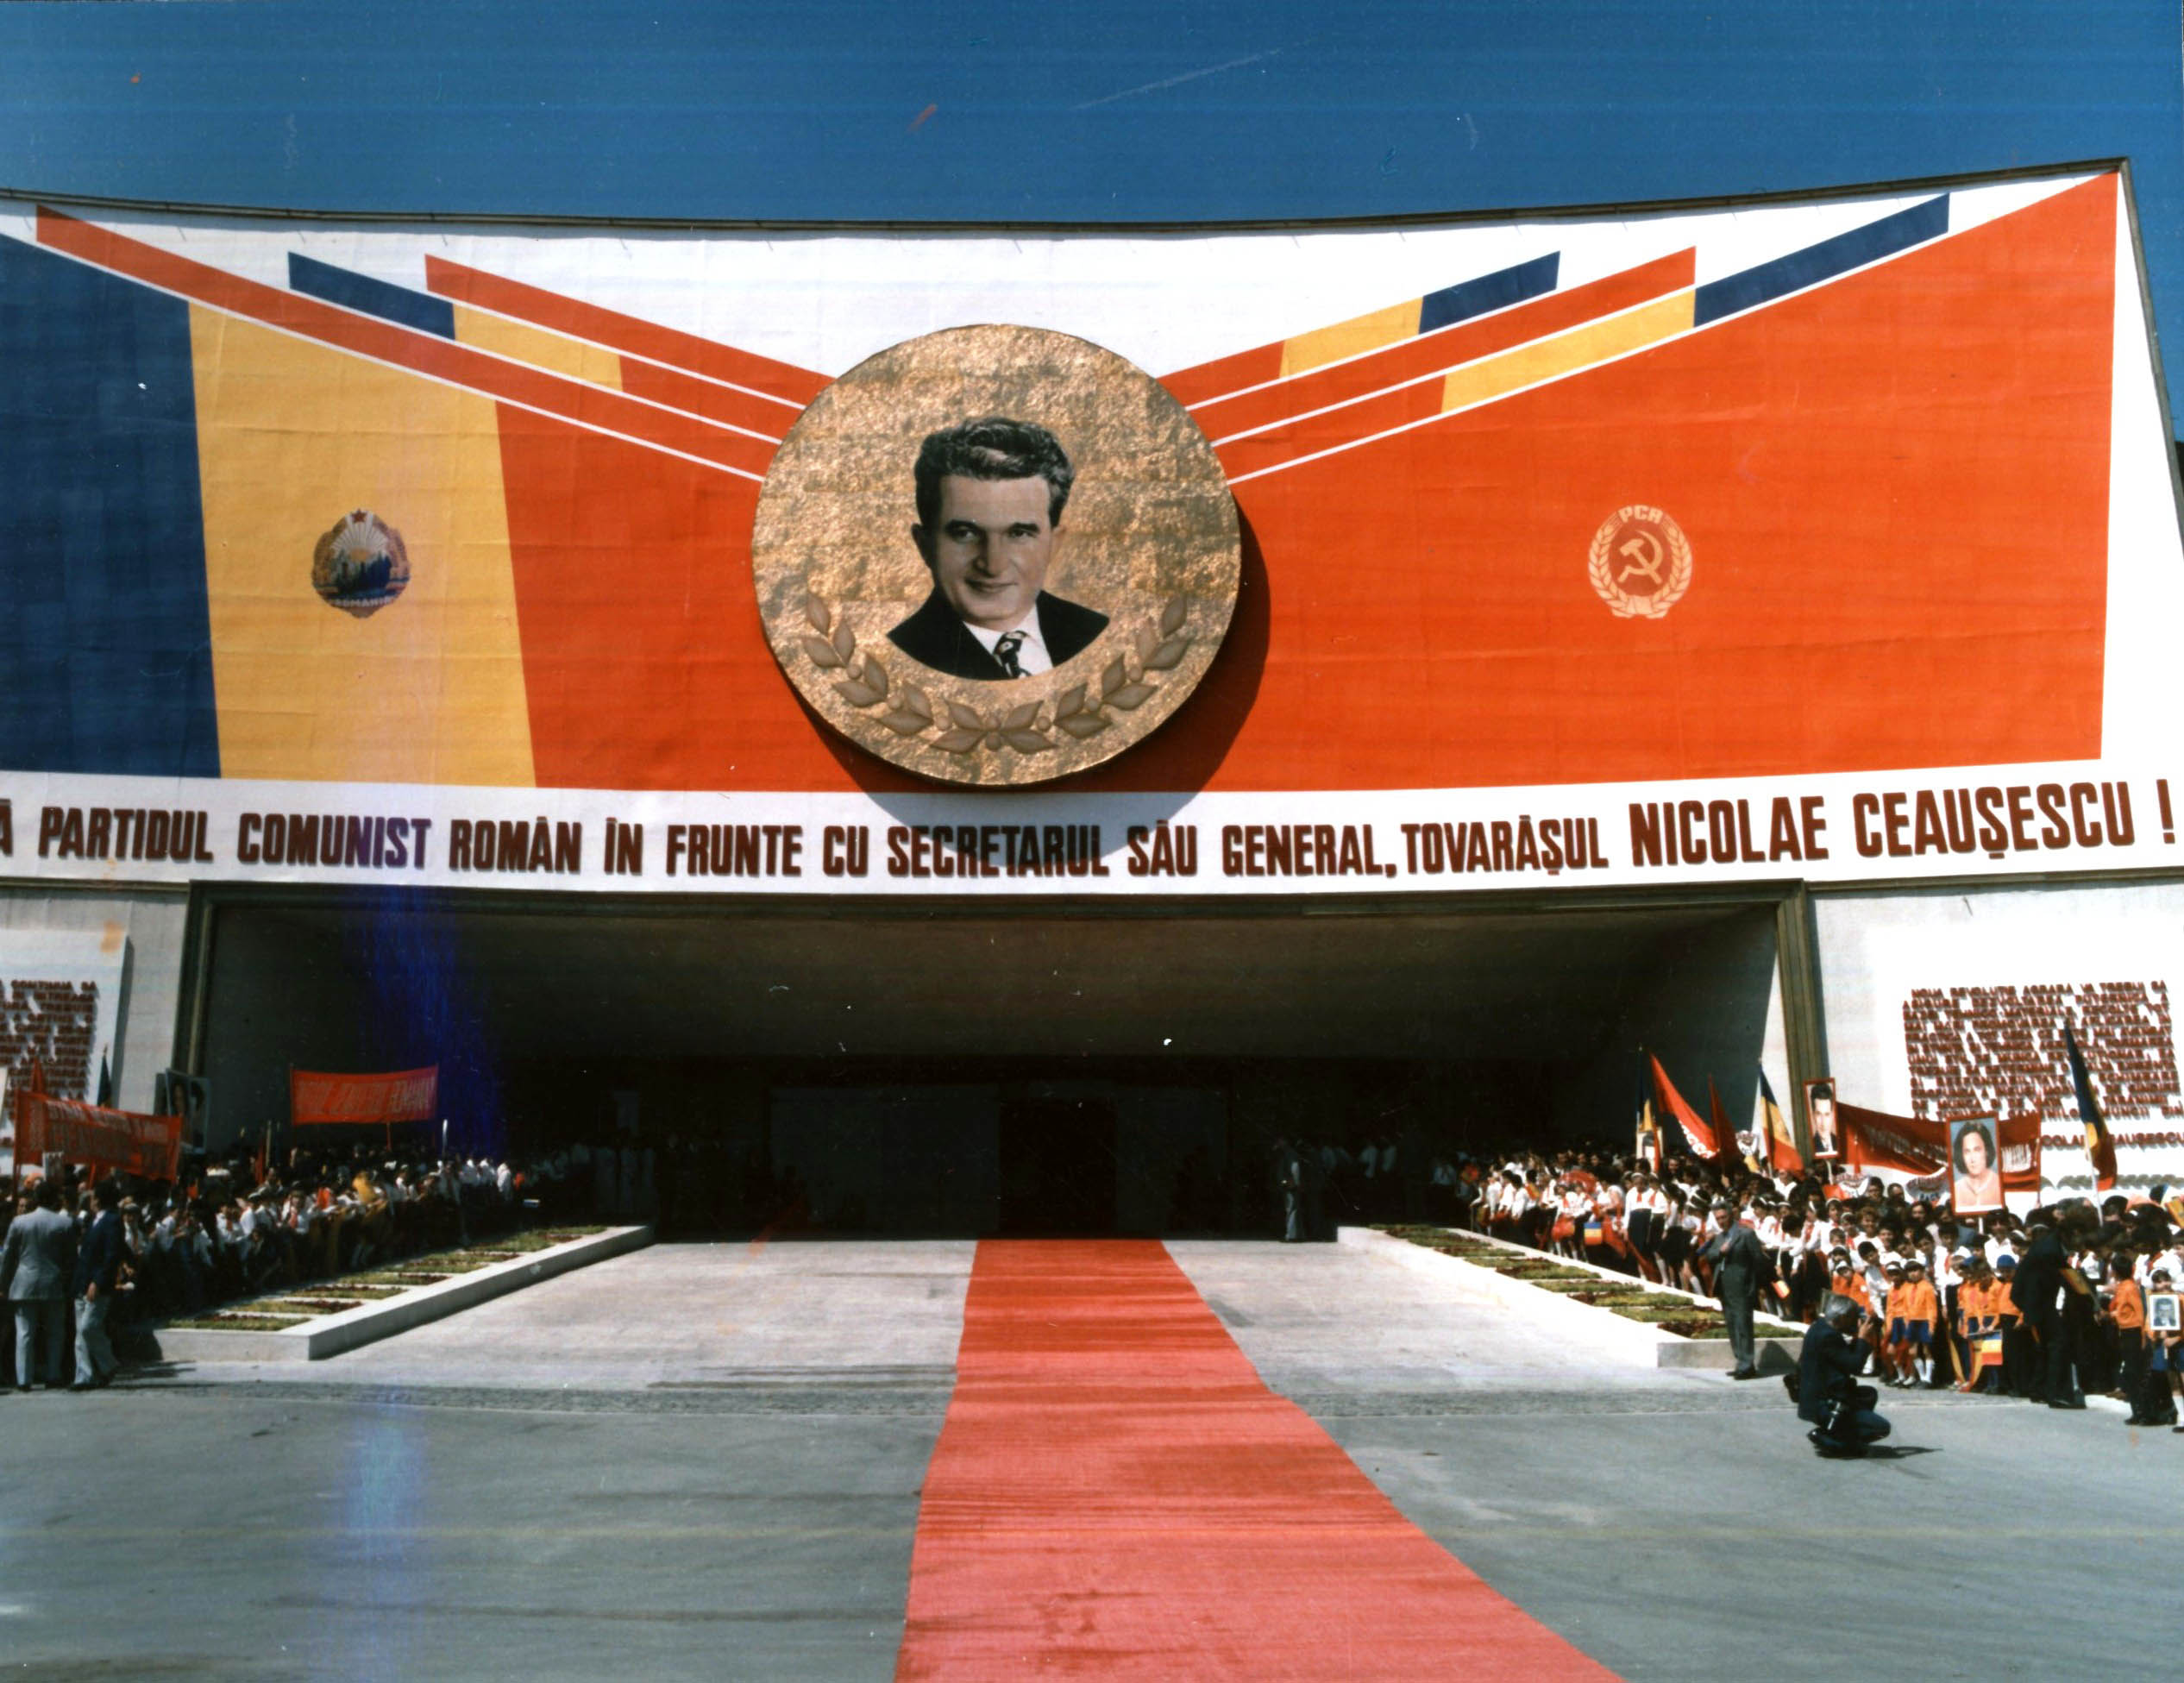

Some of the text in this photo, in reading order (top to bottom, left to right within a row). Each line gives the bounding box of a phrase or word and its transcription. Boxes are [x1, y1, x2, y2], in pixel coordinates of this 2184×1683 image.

[38, 806, 214, 863] PARTIDUL
[236, 813, 431, 869] COMUNIST
[449, 816, 582, 874] ROMÂN
[604, 817, 643, 875] ÎN
[666, 825, 802, 876] FRUNTE
[823, 826, 869, 876] CU
[888, 826, 1109, 877] SECRETARUL
[1126, 819, 1197, 876] SĂU
[1222, 825, 1396, 878] GENERAL,
[1629, 796, 1829, 866] NICOLAE
